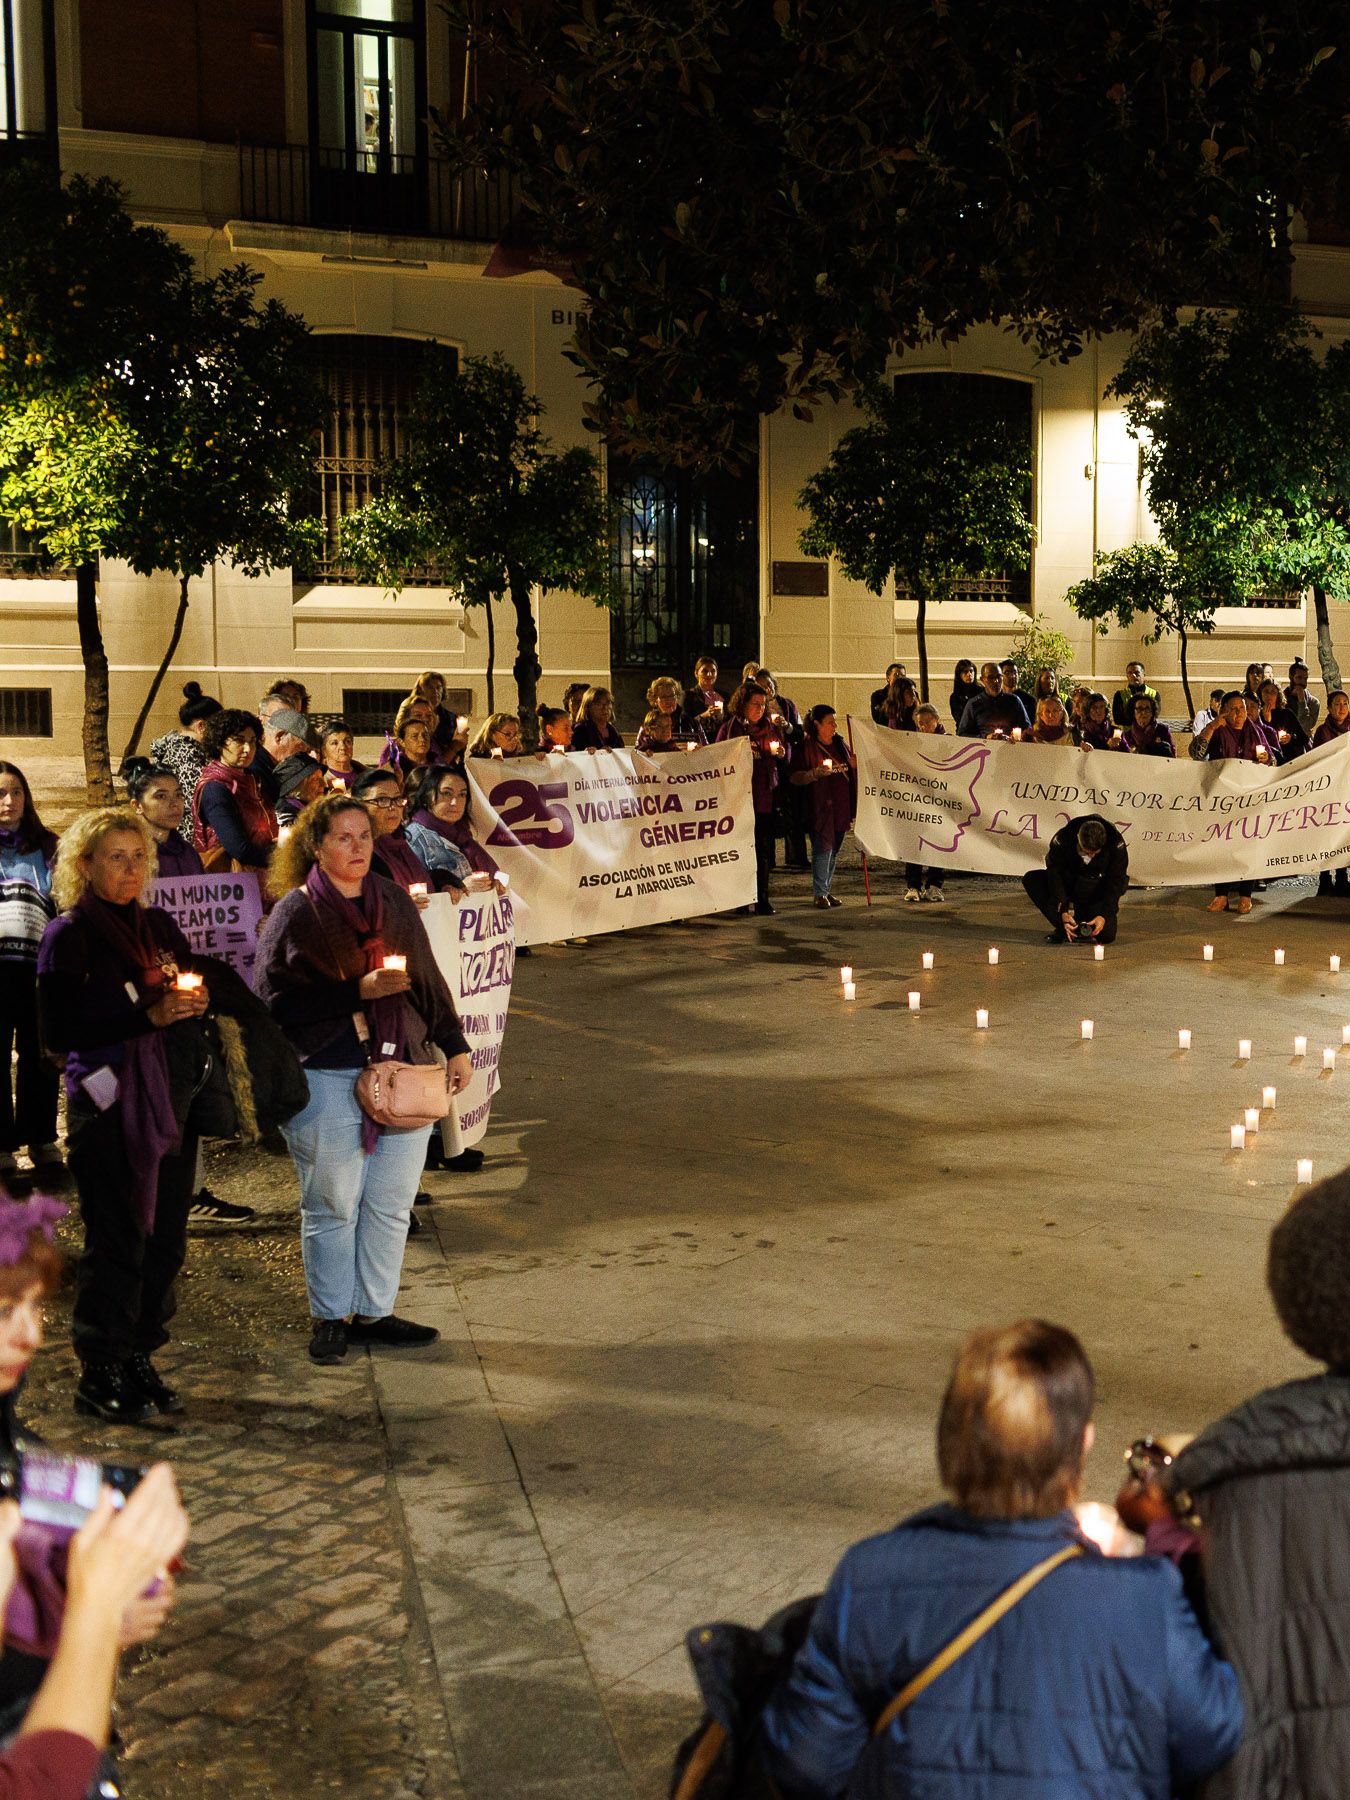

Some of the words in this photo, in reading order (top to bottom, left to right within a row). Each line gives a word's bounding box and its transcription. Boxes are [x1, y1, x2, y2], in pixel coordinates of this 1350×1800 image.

[574, 779, 591, 791] DÍA
[667, 769, 721, 785] CONTRA
[723, 765, 736, 777] LA
[880, 771, 948, 791] FEDERACIÓN
[864, 786, 877, 796] DE
[880, 788, 963, 811] ASOCIACIONES
[1011, 782, 1111, 806] UNIDAS
[1116, 791, 1165, 810] POR
[1169, 795, 1203, 812] LA
[1209, 774, 1332, 815] IGUALDAD
[485, 779, 575, 849] 25
[576, 793, 683, 824] VIOLENCIA
[694, 797, 719, 812] DE
[881, 806, 894, 817] DE
[896, 810, 943, 825] MUJERES
[640, 815, 735, 849] GÉNERO
[985, 810, 1042, 840] LA
[1141, 831, 1163, 842] DE
[1166, 831, 1194, 843] LAS
[579, 863, 655, 888] ASOCIACIÓN
[658, 861, 673, 875] DE
[675, 850, 740, 872] MUJERES
[1266, 856, 1290, 867] JEREZ
[1292, 854, 1304, 864] DE
[1306, 852, 1318, 862] LA
[181, 883, 245, 906] MUNDO
[615, 886, 633, 899] LA
[637, 874, 695, 896] MARQUESA
